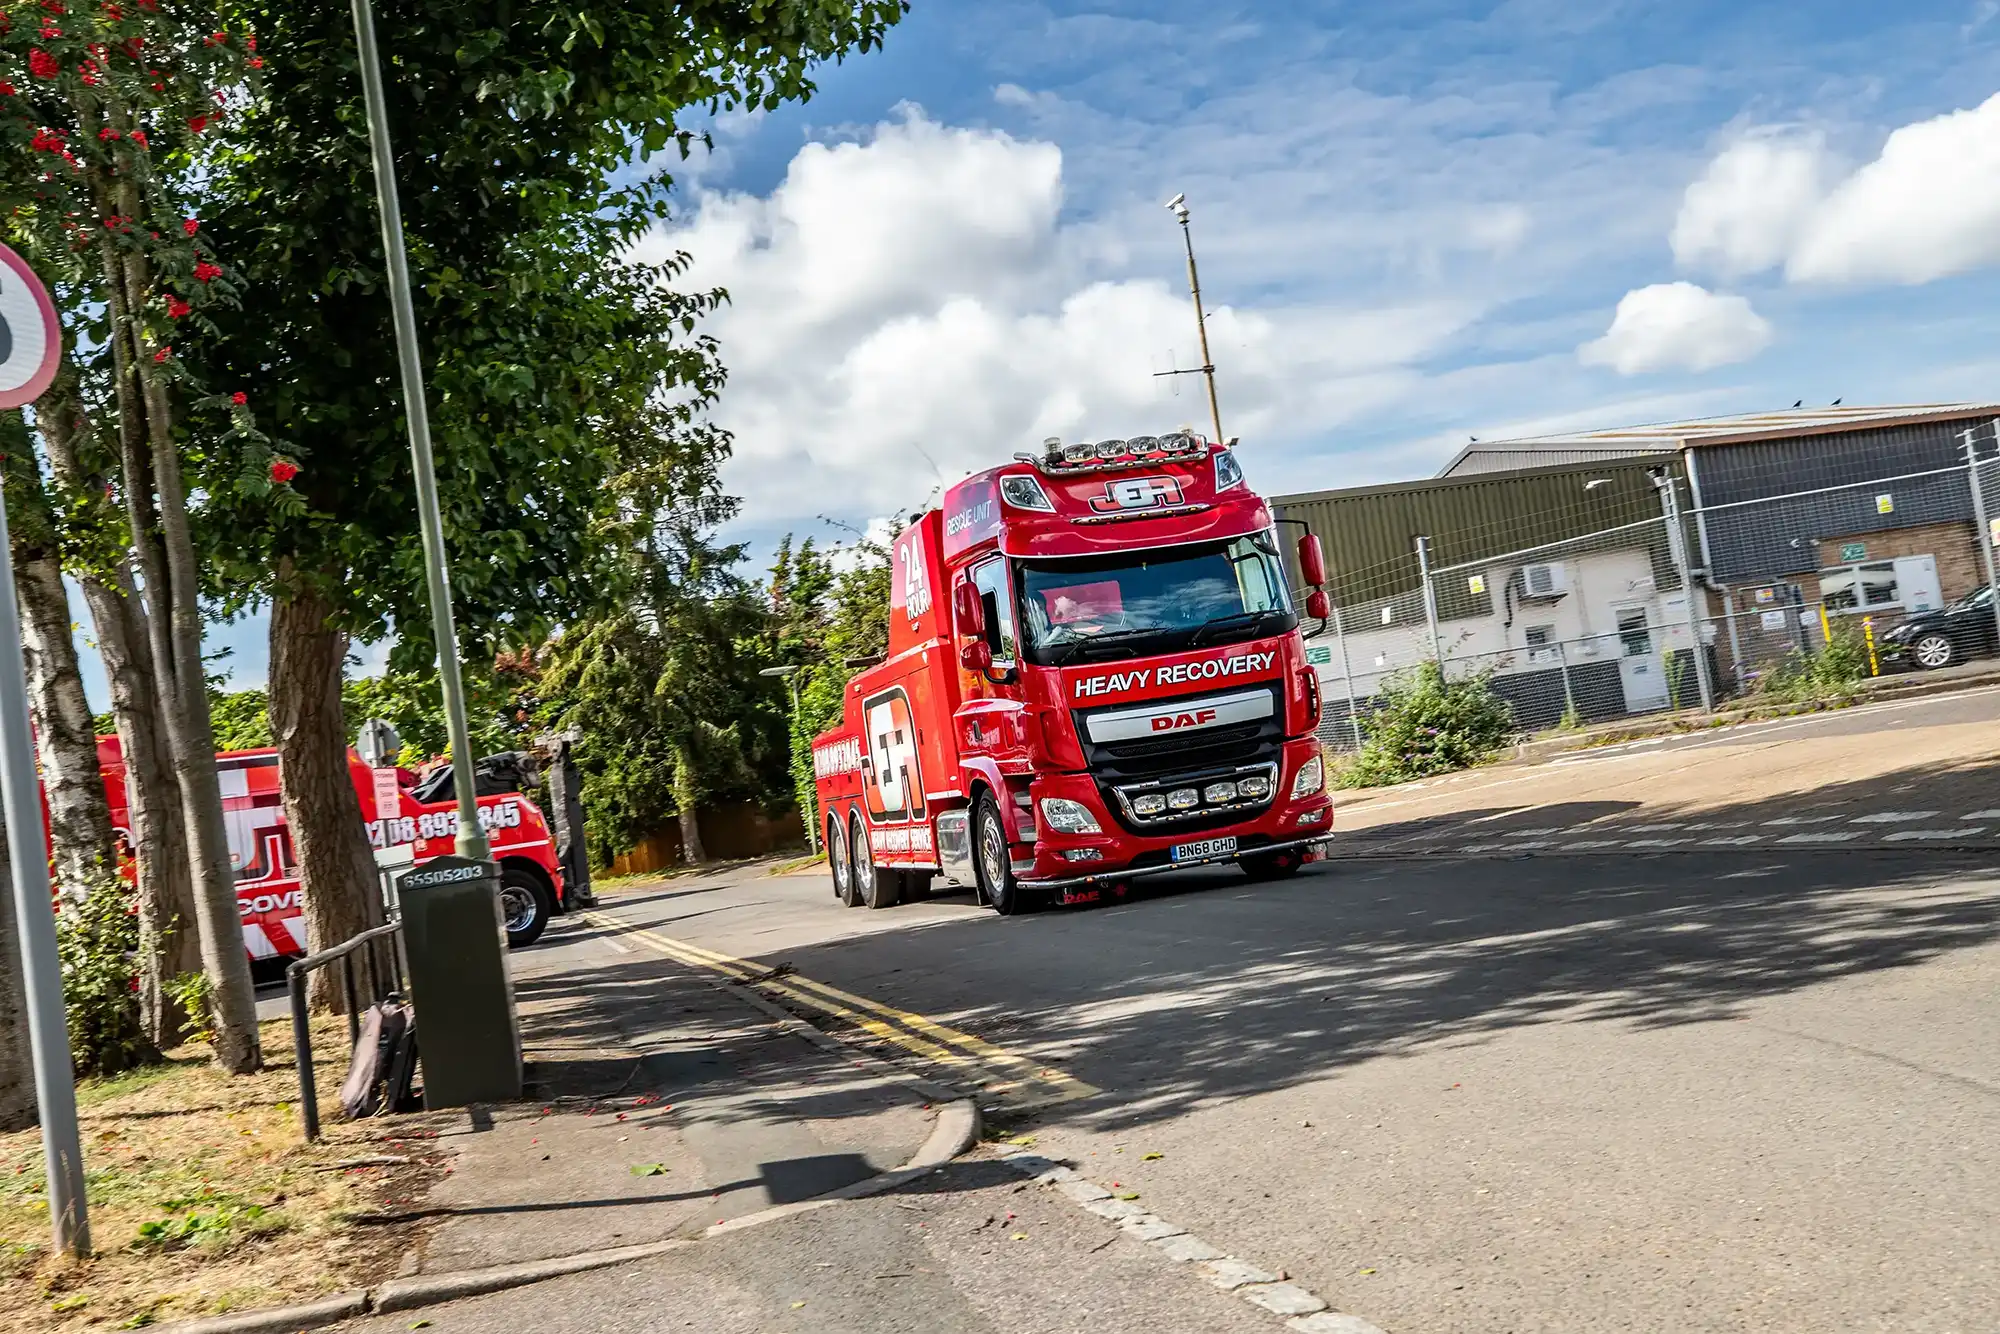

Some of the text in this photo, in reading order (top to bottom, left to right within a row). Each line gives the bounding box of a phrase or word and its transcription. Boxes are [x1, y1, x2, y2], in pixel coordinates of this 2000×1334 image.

[946, 499, 992, 537] RESCUE UNIT
[901, 533, 924, 597] 24
[906, 588, 930, 621] HOUR
[1075, 669, 1151, 698] HEAVY
[1156, 651, 1276, 686] RECOVERY
[1150, 708, 1217, 732] DAF
[1178, 837, 1236, 858] BN68 GHD
